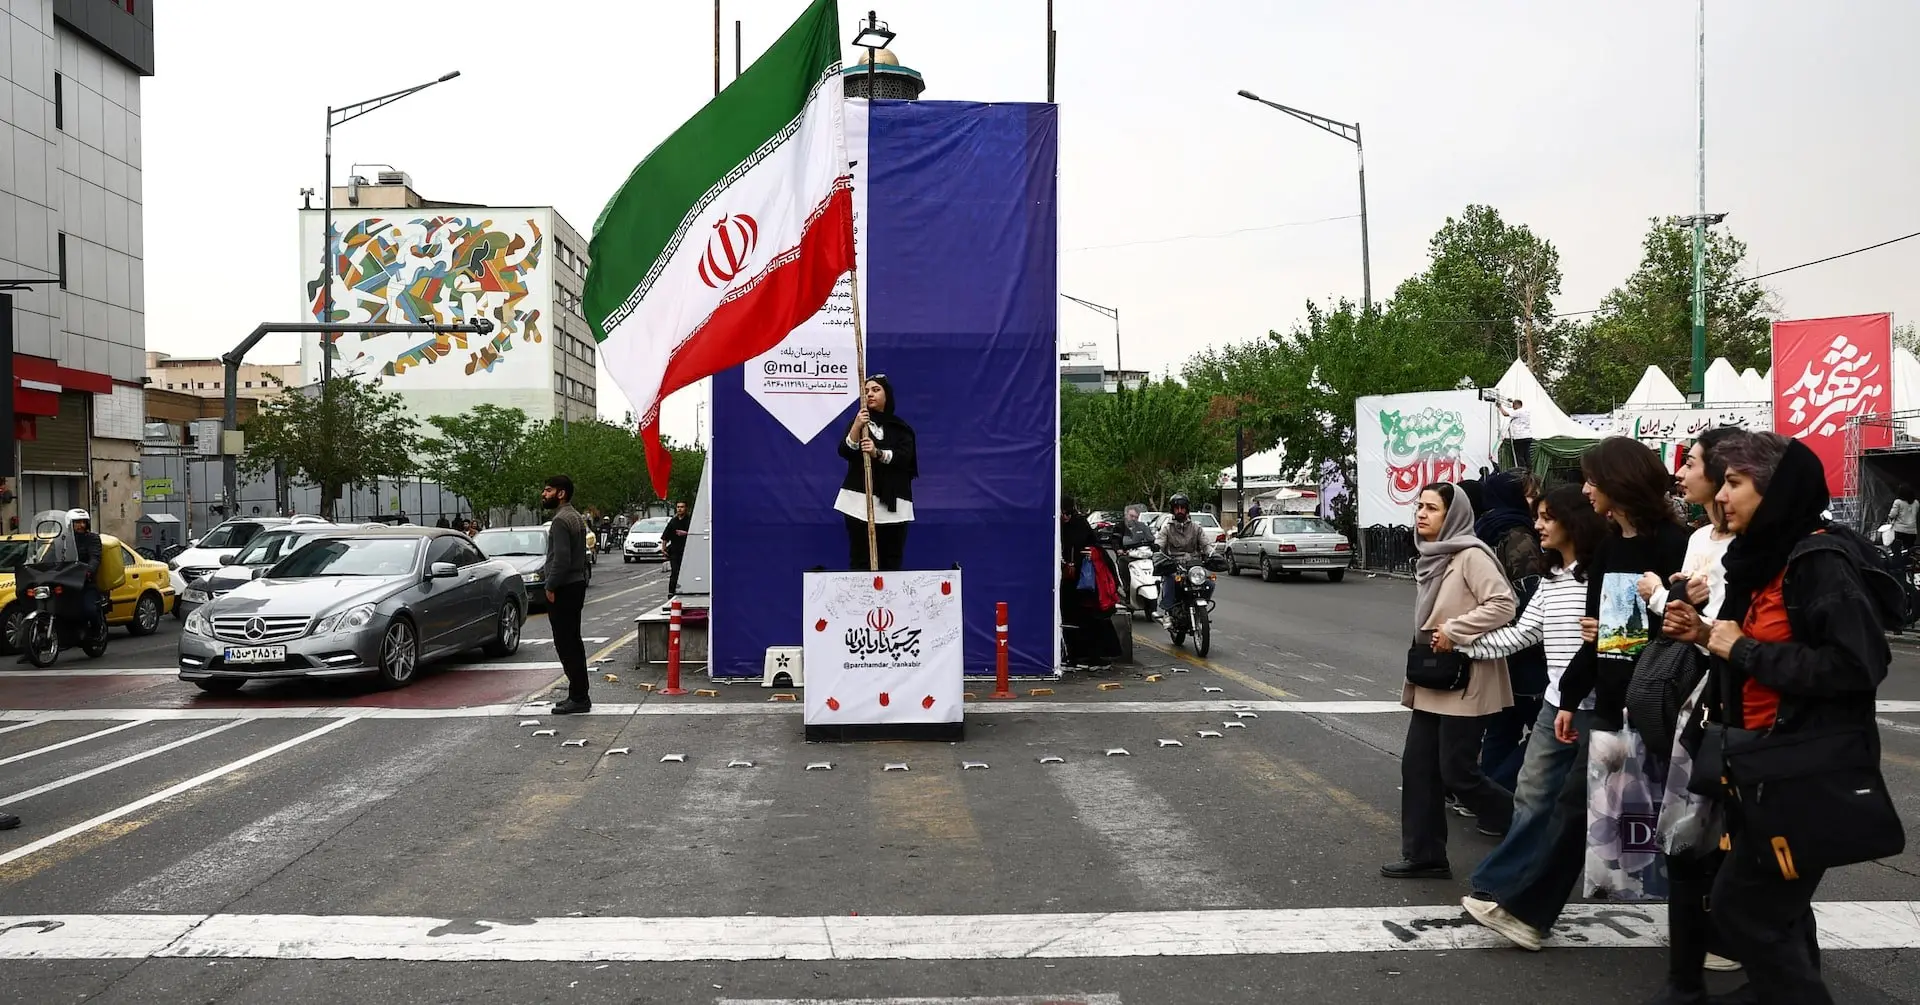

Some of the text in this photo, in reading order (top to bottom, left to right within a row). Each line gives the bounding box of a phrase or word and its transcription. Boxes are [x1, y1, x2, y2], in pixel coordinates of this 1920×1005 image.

[764, 360, 848, 376] @mal_jaee
[828, 380, 848, 391] شماره
[1640, 418, 1661, 435] ایران
